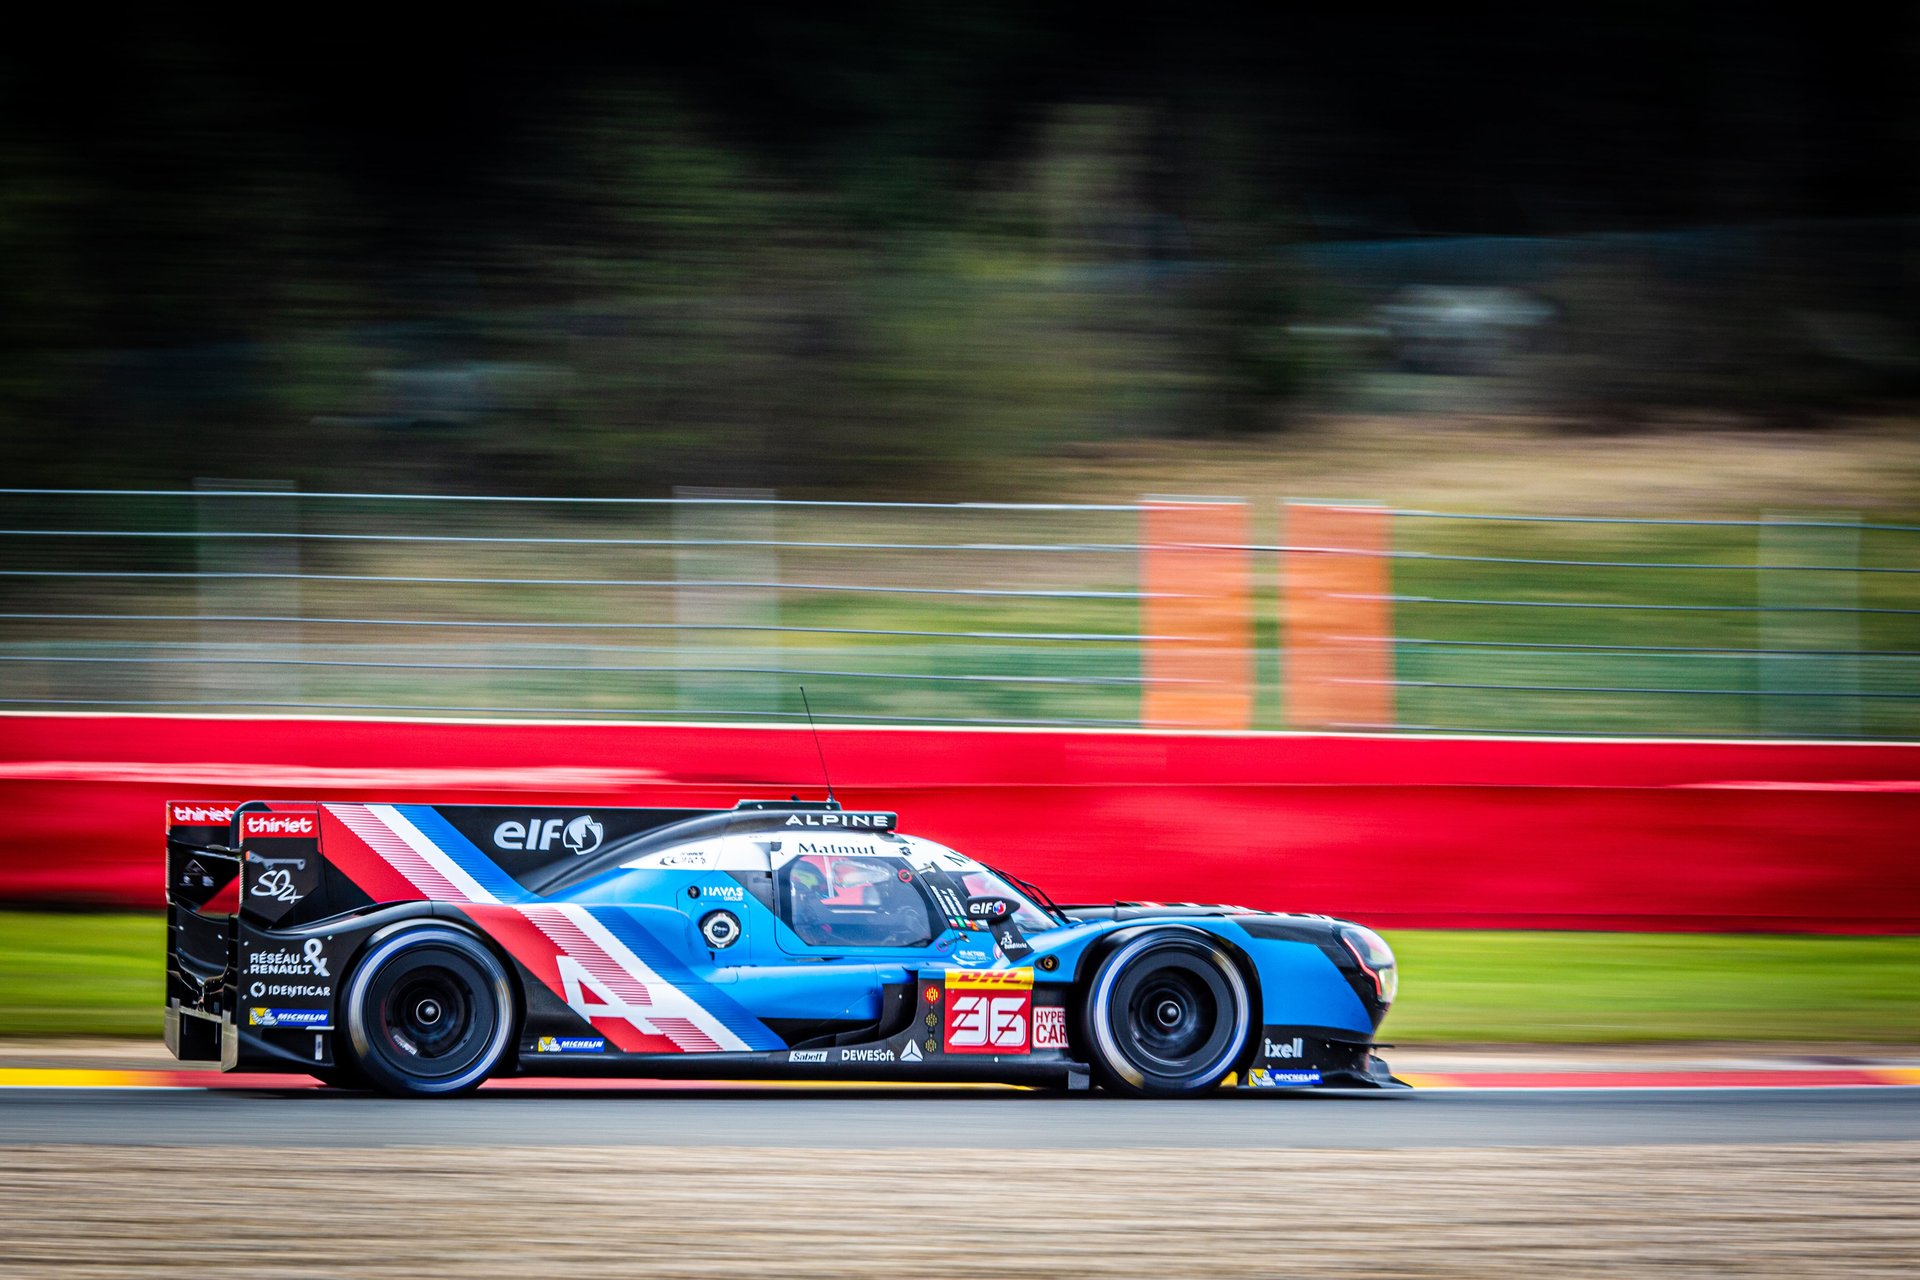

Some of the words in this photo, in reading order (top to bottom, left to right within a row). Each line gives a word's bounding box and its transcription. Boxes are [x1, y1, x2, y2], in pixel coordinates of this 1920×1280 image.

[174, 806, 235, 822] thiriet
[785, 814, 889, 827] ALPINE
[247, 817, 313, 833] thiriet
[493, 818, 564, 850] elf
[798, 842, 876, 856] Matmut
[703, 886, 744, 897] HAVAS
[969, 902, 993, 915] elf
[250, 951, 300, 964] RÉSEAU
[250, 964, 312, 975] RENAULT
[957, 971, 1024, 984] DHL
[268, 985, 331, 997] IDENTICAR
[277, 1012, 327, 1022] MICHELIN
[949, 997, 1026, 1047] 36
[1036, 1023, 1068, 1044] CAR
[561, 1040, 603, 1049] MICHELIN
[1264, 1037, 1303, 1058] ixell
[841, 1049, 895, 1061] DEWESoft
